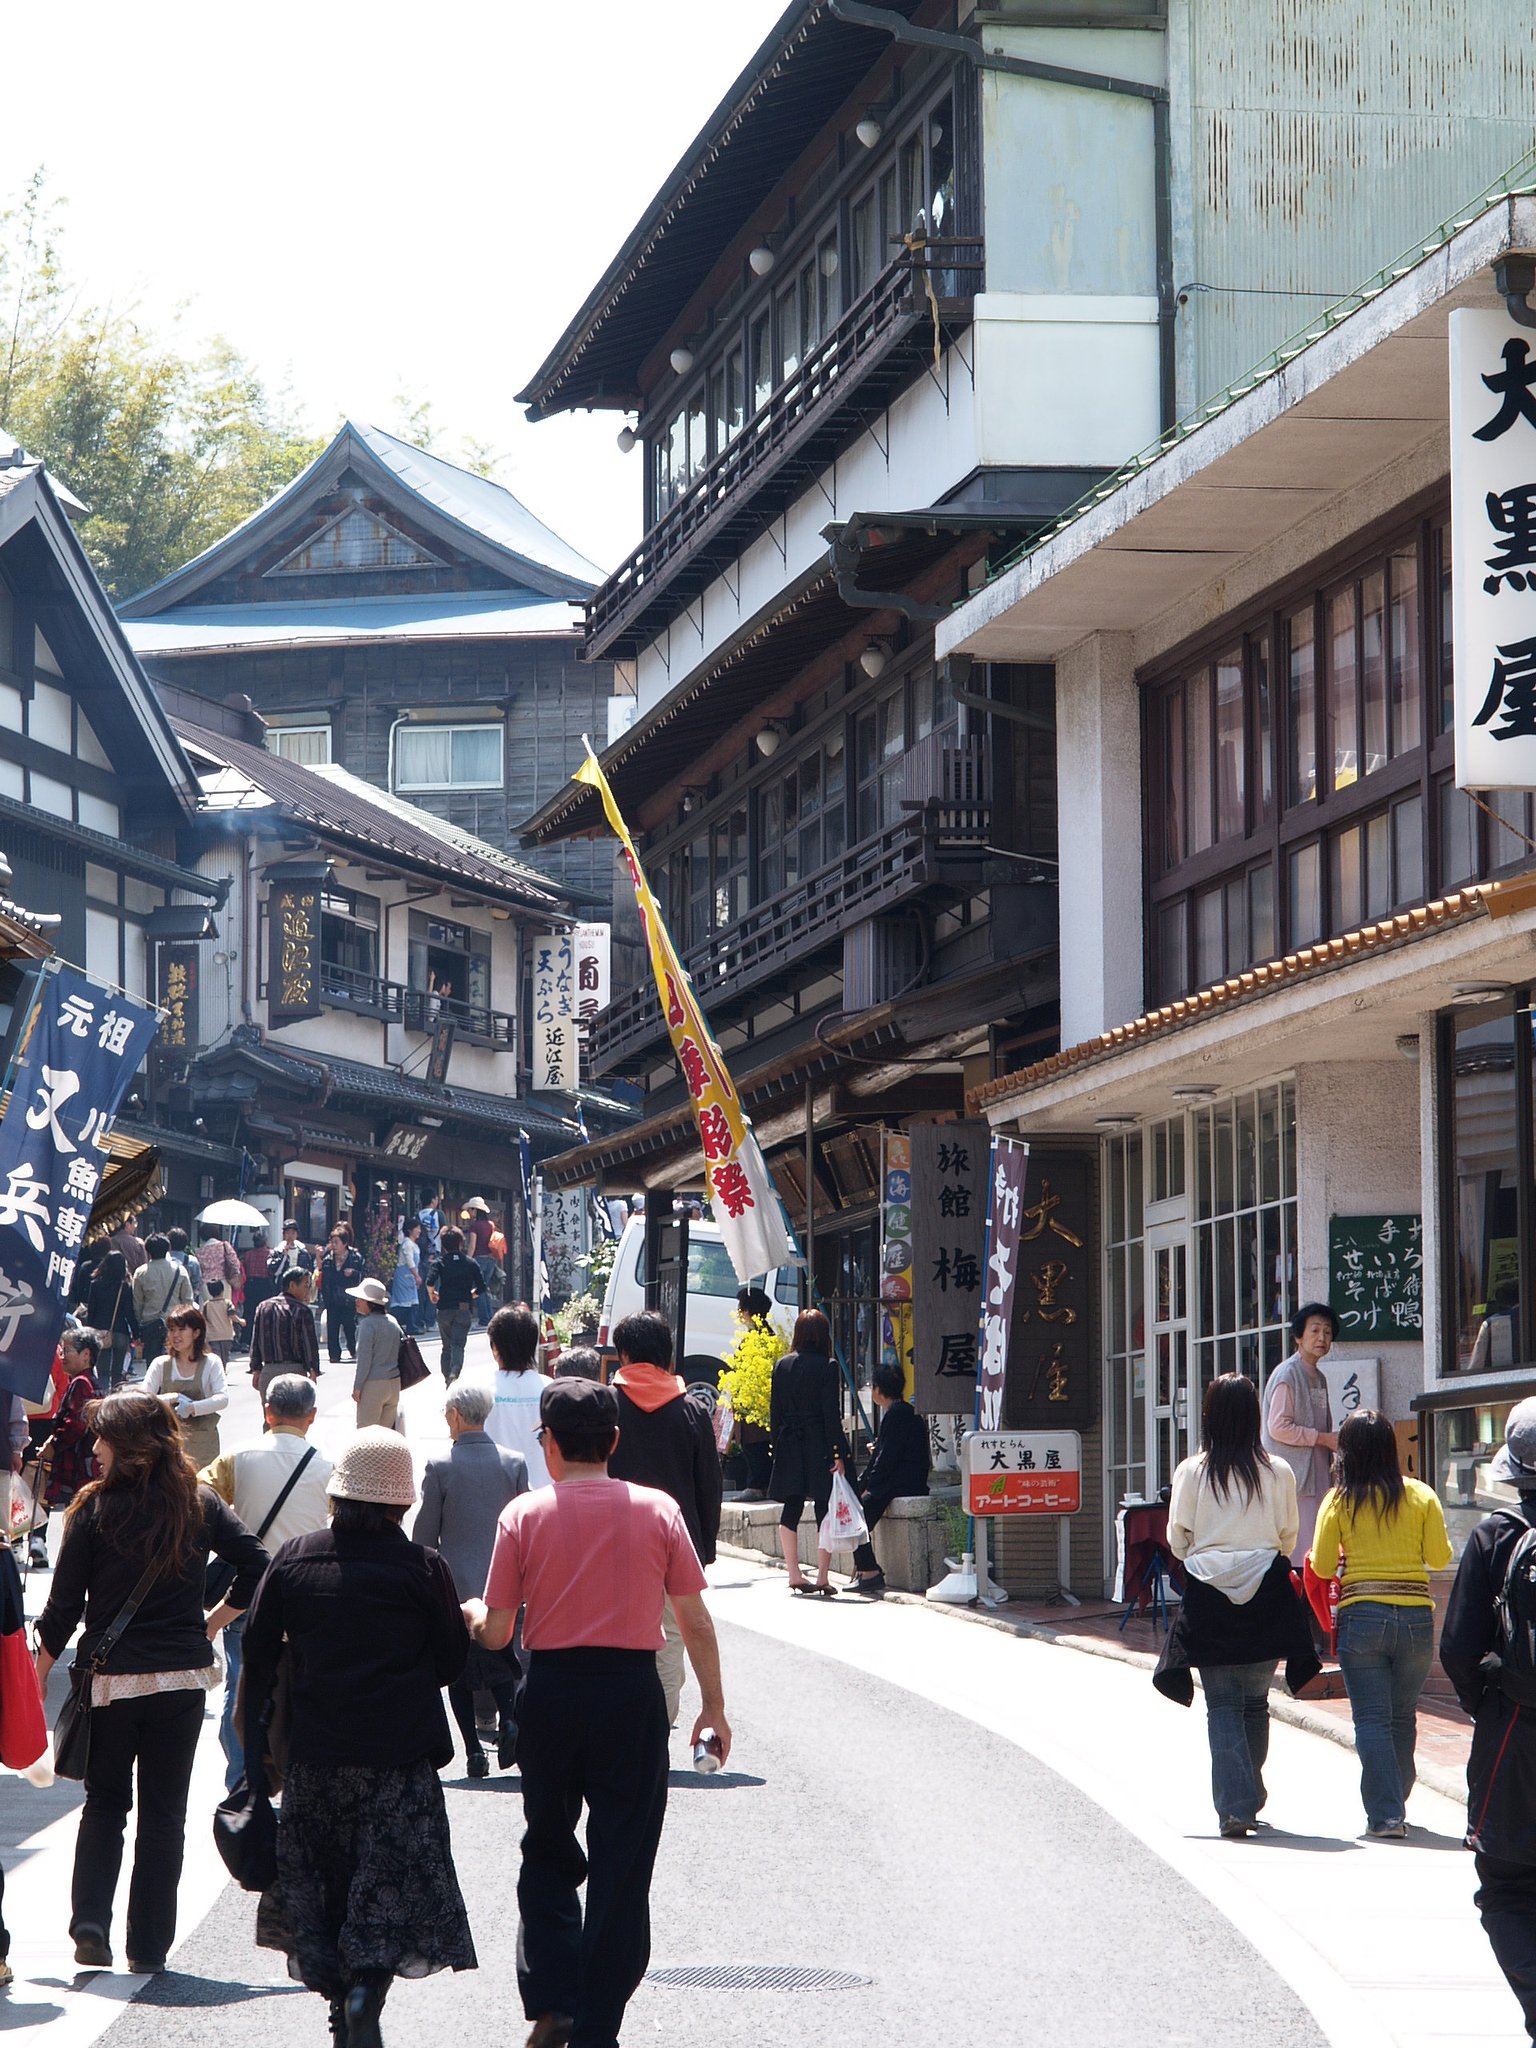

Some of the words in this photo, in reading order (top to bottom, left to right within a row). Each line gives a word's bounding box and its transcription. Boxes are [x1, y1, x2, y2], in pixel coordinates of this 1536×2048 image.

[1471, 337, 1536, 741] 大黒屋
[535, 950, 554, 1025] 天ぷら
[556, 937, 573, 1016] うなぎ
[56, 994, 136, 1057] 元祖
[544, 1028, 566, 1086] 近江屋
[1342, 1247, 1423, 1270] せいろ
[1019, 1178, 1084, 1402] 大黒屋
[981, 1440, 1025, 1449] れすとらん
[990, 1449, 1061, 1470] 大黒屋
[975, 1493, 1071, 1509] アートコーヒー
